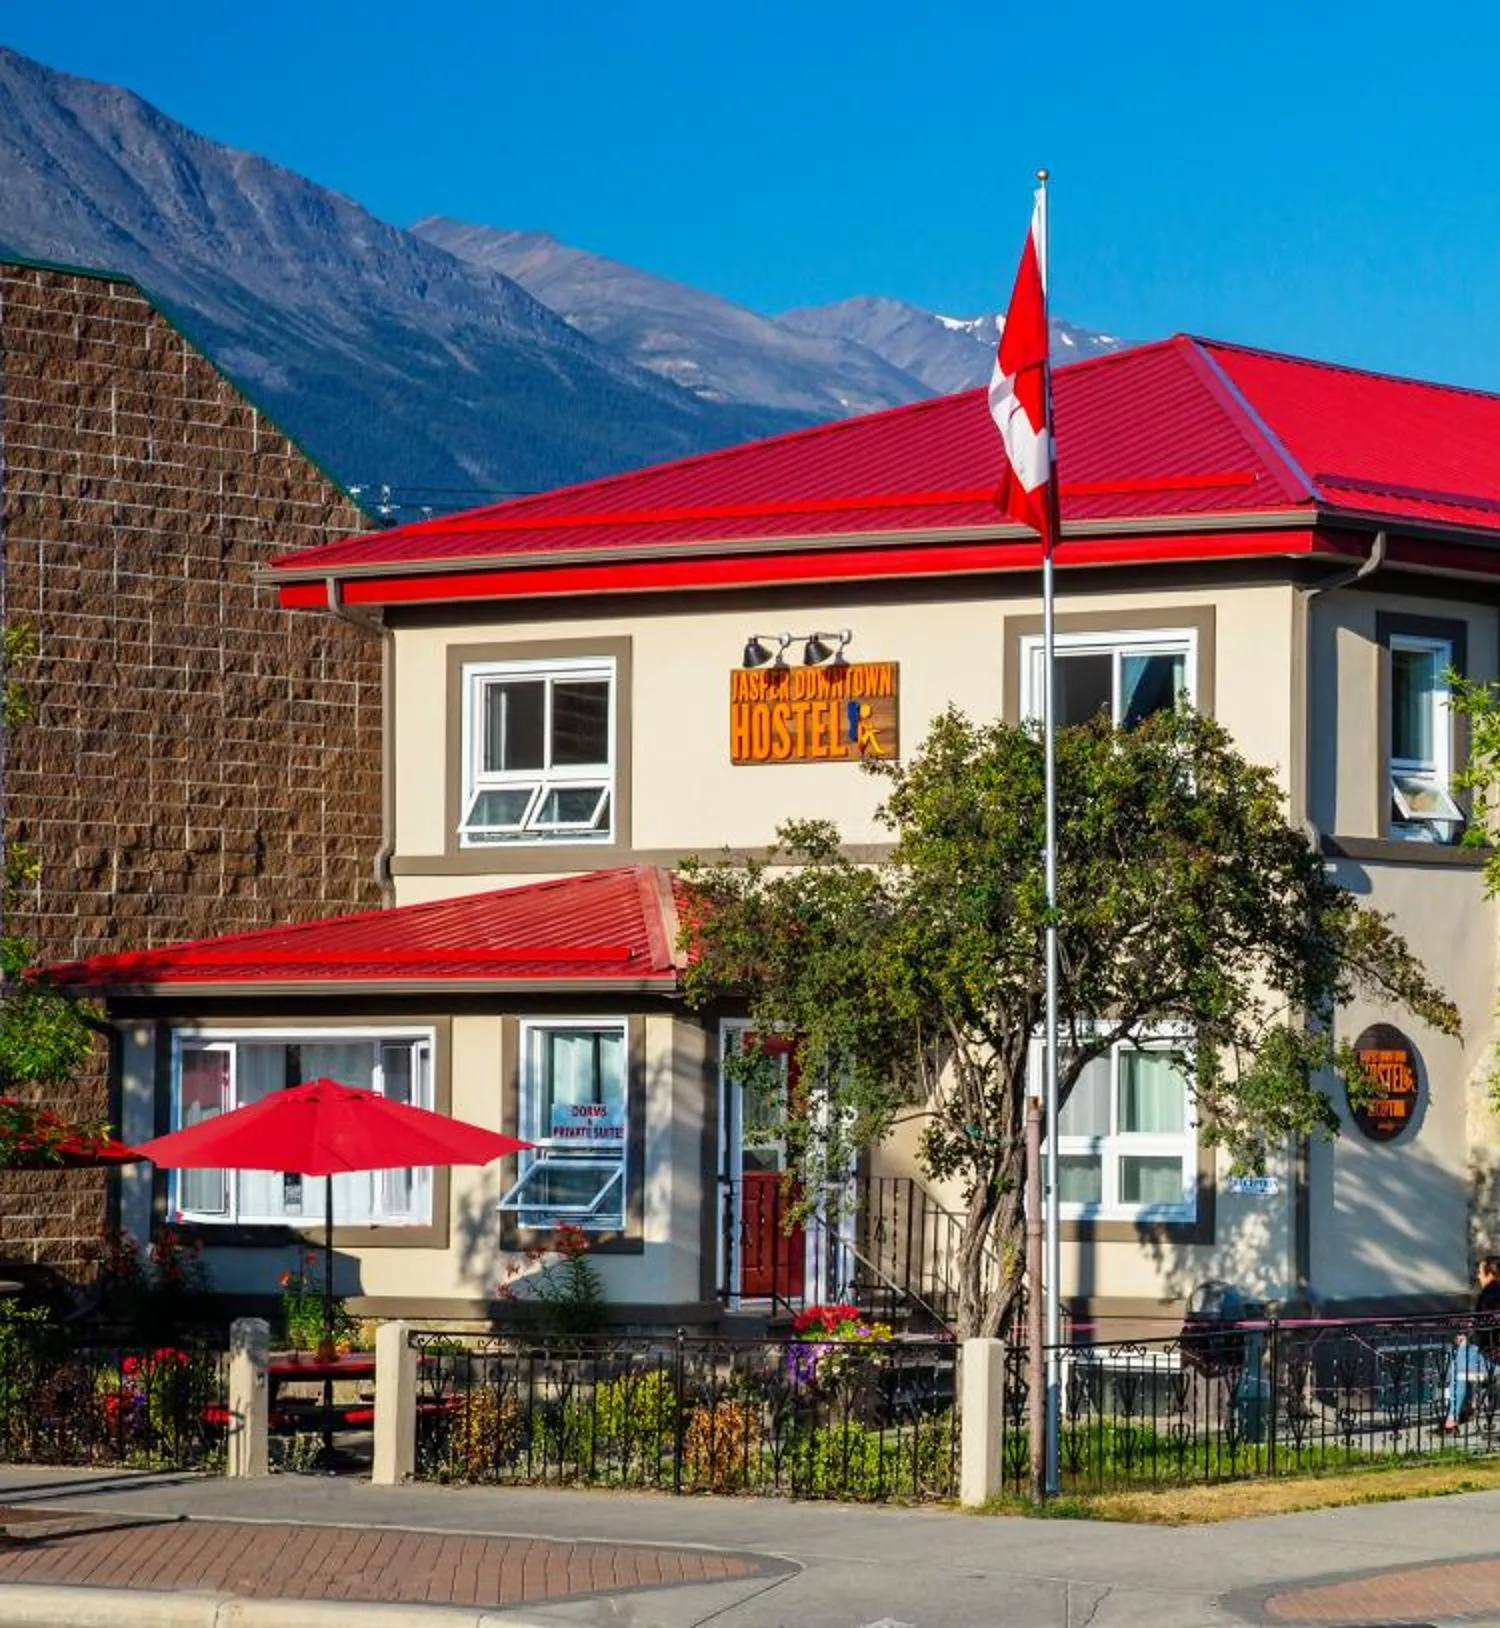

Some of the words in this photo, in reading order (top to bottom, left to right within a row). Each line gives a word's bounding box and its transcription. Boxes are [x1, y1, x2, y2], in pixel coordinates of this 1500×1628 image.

[733, 668, 790, 702] JASPER
[795, 664, 891, 700] DOWNTOWN
[732, 701, 847, 760] HOSTEL
[1361, 1063, 1407, 1092] OSTEL
[554, 1126, 592, 1139] PRIVATE
